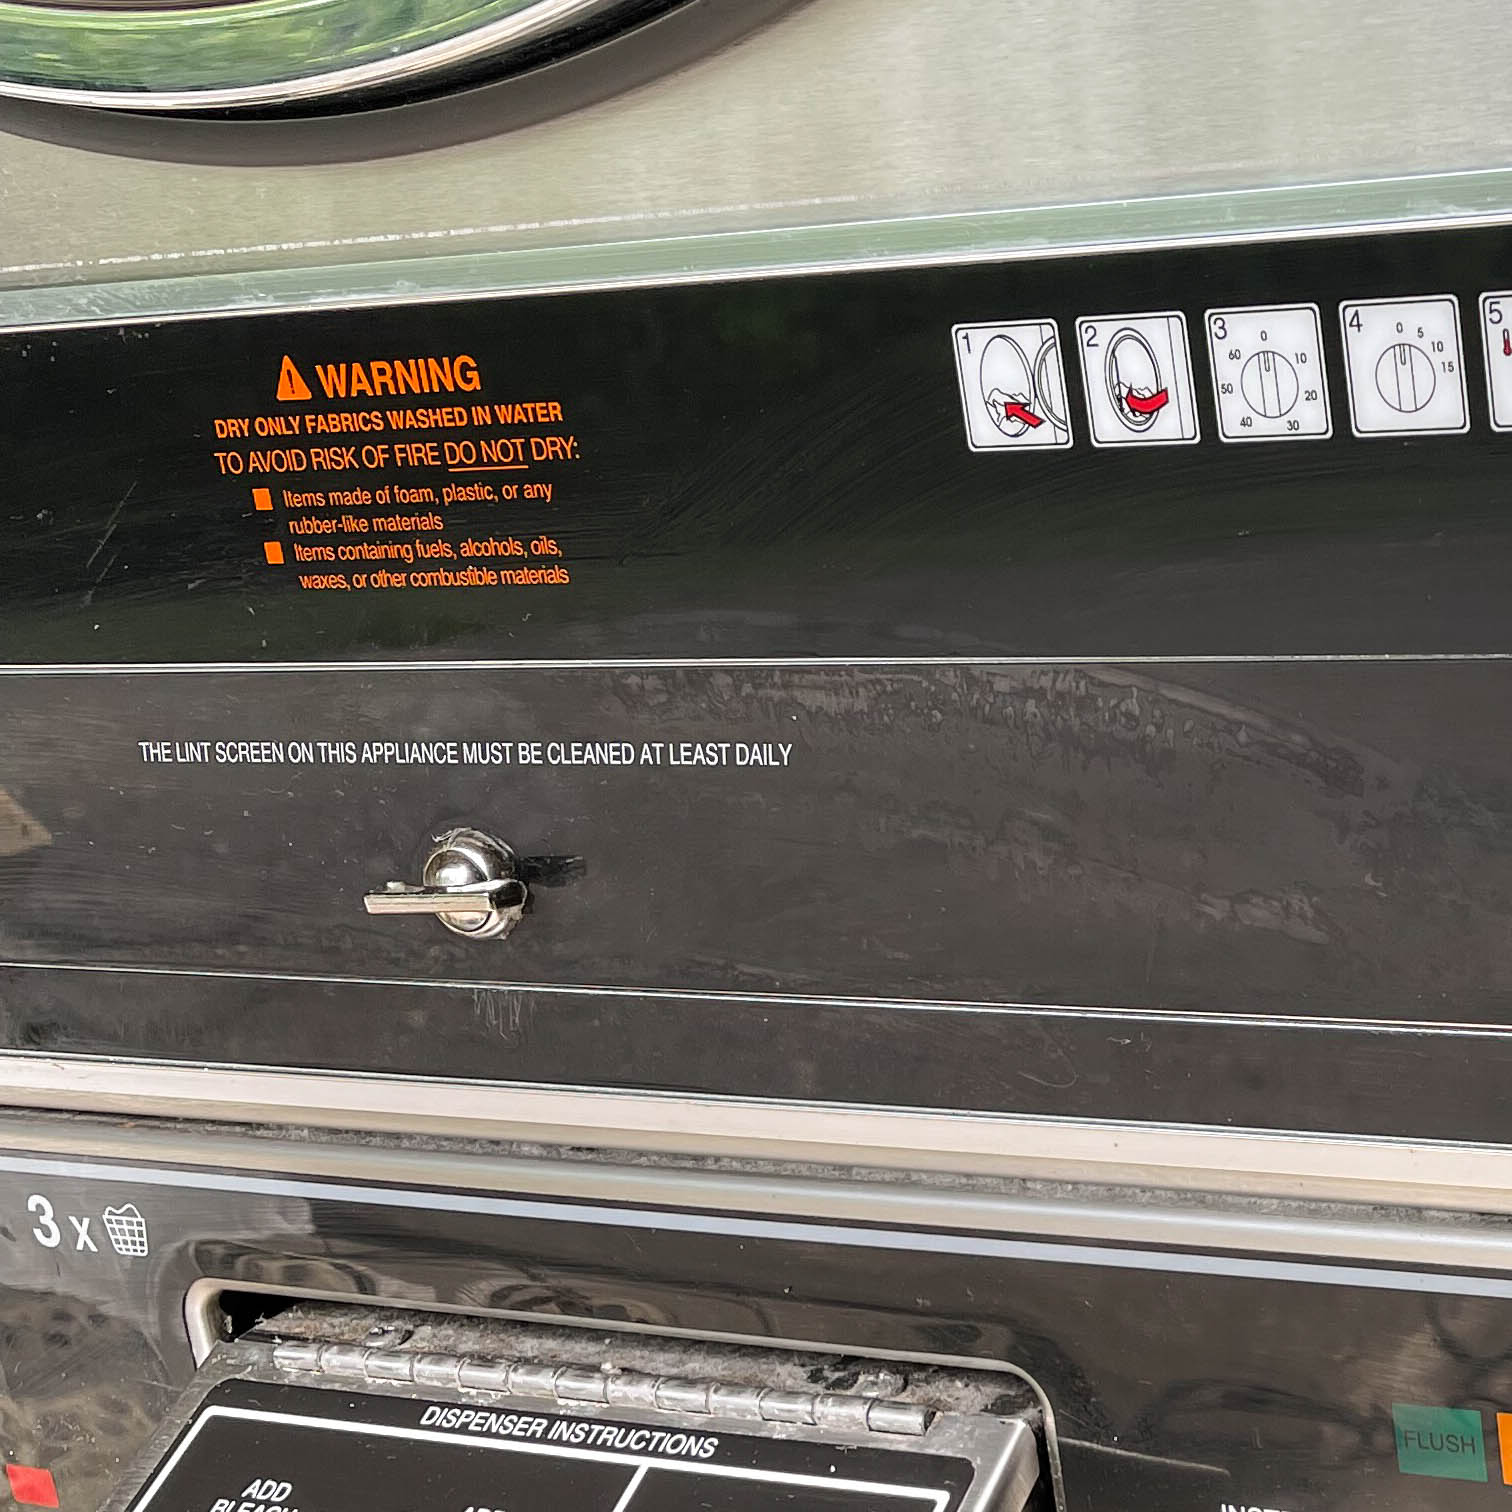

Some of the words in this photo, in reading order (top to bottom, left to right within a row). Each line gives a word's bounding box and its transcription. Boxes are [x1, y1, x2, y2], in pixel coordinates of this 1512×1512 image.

[1348, 309, 1363, 333] 4
[1488, 300, 1503, 324] 5
[1084, 325, 1099, 347] 2
[1213, 317, 1228, 340] 3
[1260, 330, 1268, 342] 0
[1396, 322, 1403, 334] 0
[1417, 326, 1424, 338] 5
[962, 333, 972, 354] 1
[1431, 341, 1444, 353] 10
[1228, 349, 1241, 361] 60
[1296, 352, 1307, 364] 10
[315, 355, 482, 399] WARNING
[1441, 361, 1455, 373] 15
[1221, 382, 1234, 395] 50
[1304, 389, 1317, 402] 20
[214, 418, 249, 438] DRY
[254, 416, 300, 436] ONLY
[305, 411, 384, 434] FABRICS
[387, 407, 468, 431] WASHED
[471, 405, 492, 426] IN
[494, 402, 563, 424] WATER
[1239, 416, 1253, 428] 40
[1286, 419, 1300, 431] 30
[214, 452, 243, 474] TO
[248, 449, 307, 472] AVOID
[310, 447, 359, 470] RISK
[362, 445, 389, 468] OF
[394, 443, 441, 466] FIRE
[444, 441, 476, 464] DO
[480, 438, 525, 462] NOT
[530, 436, 579, 460] DRY:
[283, 490, 326, 507] Items
[328, 487, 372, 505] made
[376, 485, 390, 504] of
[394, 485, 439, 504] foam,
[442, 482, 498, 506] plastic,
[502, 485, 518, 499] or
[523, 484, 552, 503] any
[289, 515, 369, 534] rubber-like
[372, 512, 443, 531] materials
[294, 543, 335, 561] Items
[338, 543, 414, 563] containing
[415, 539, 457, 560] fuels,
[460, 537, 527, 558] alcohols,
[530, 536, 562, 557] oils,
[138, 742, 172, 762] THE
[176, 742, 211, 762] LINT
[216, 742, 284, 763] SCREEN
[288, 742, 313, 763] ON
[317, 742, 356, 763] THIS
[361, 743, 458, 764] APPLIANCE
[463, 742, 513, 764] MUST
[518, 743, 543, 764] BE
[547, 743, 634, 764] CLEANED
[640, 743, 664, 764] AT
[669, 743, 730, 765] LEAST
[736, 743, 792, 765] DAILY
[27, 1194, 61, 1248] 3
[68, 1215, 98, 1252] x
[420, 1406, 548, 1438] DISPENSER
[547, 1420, 719, 1458] INSTRUCTIONS
[1404, 1430, 1476, 1455] FLUSH
[241, 1479, 292, 1501] ADD
